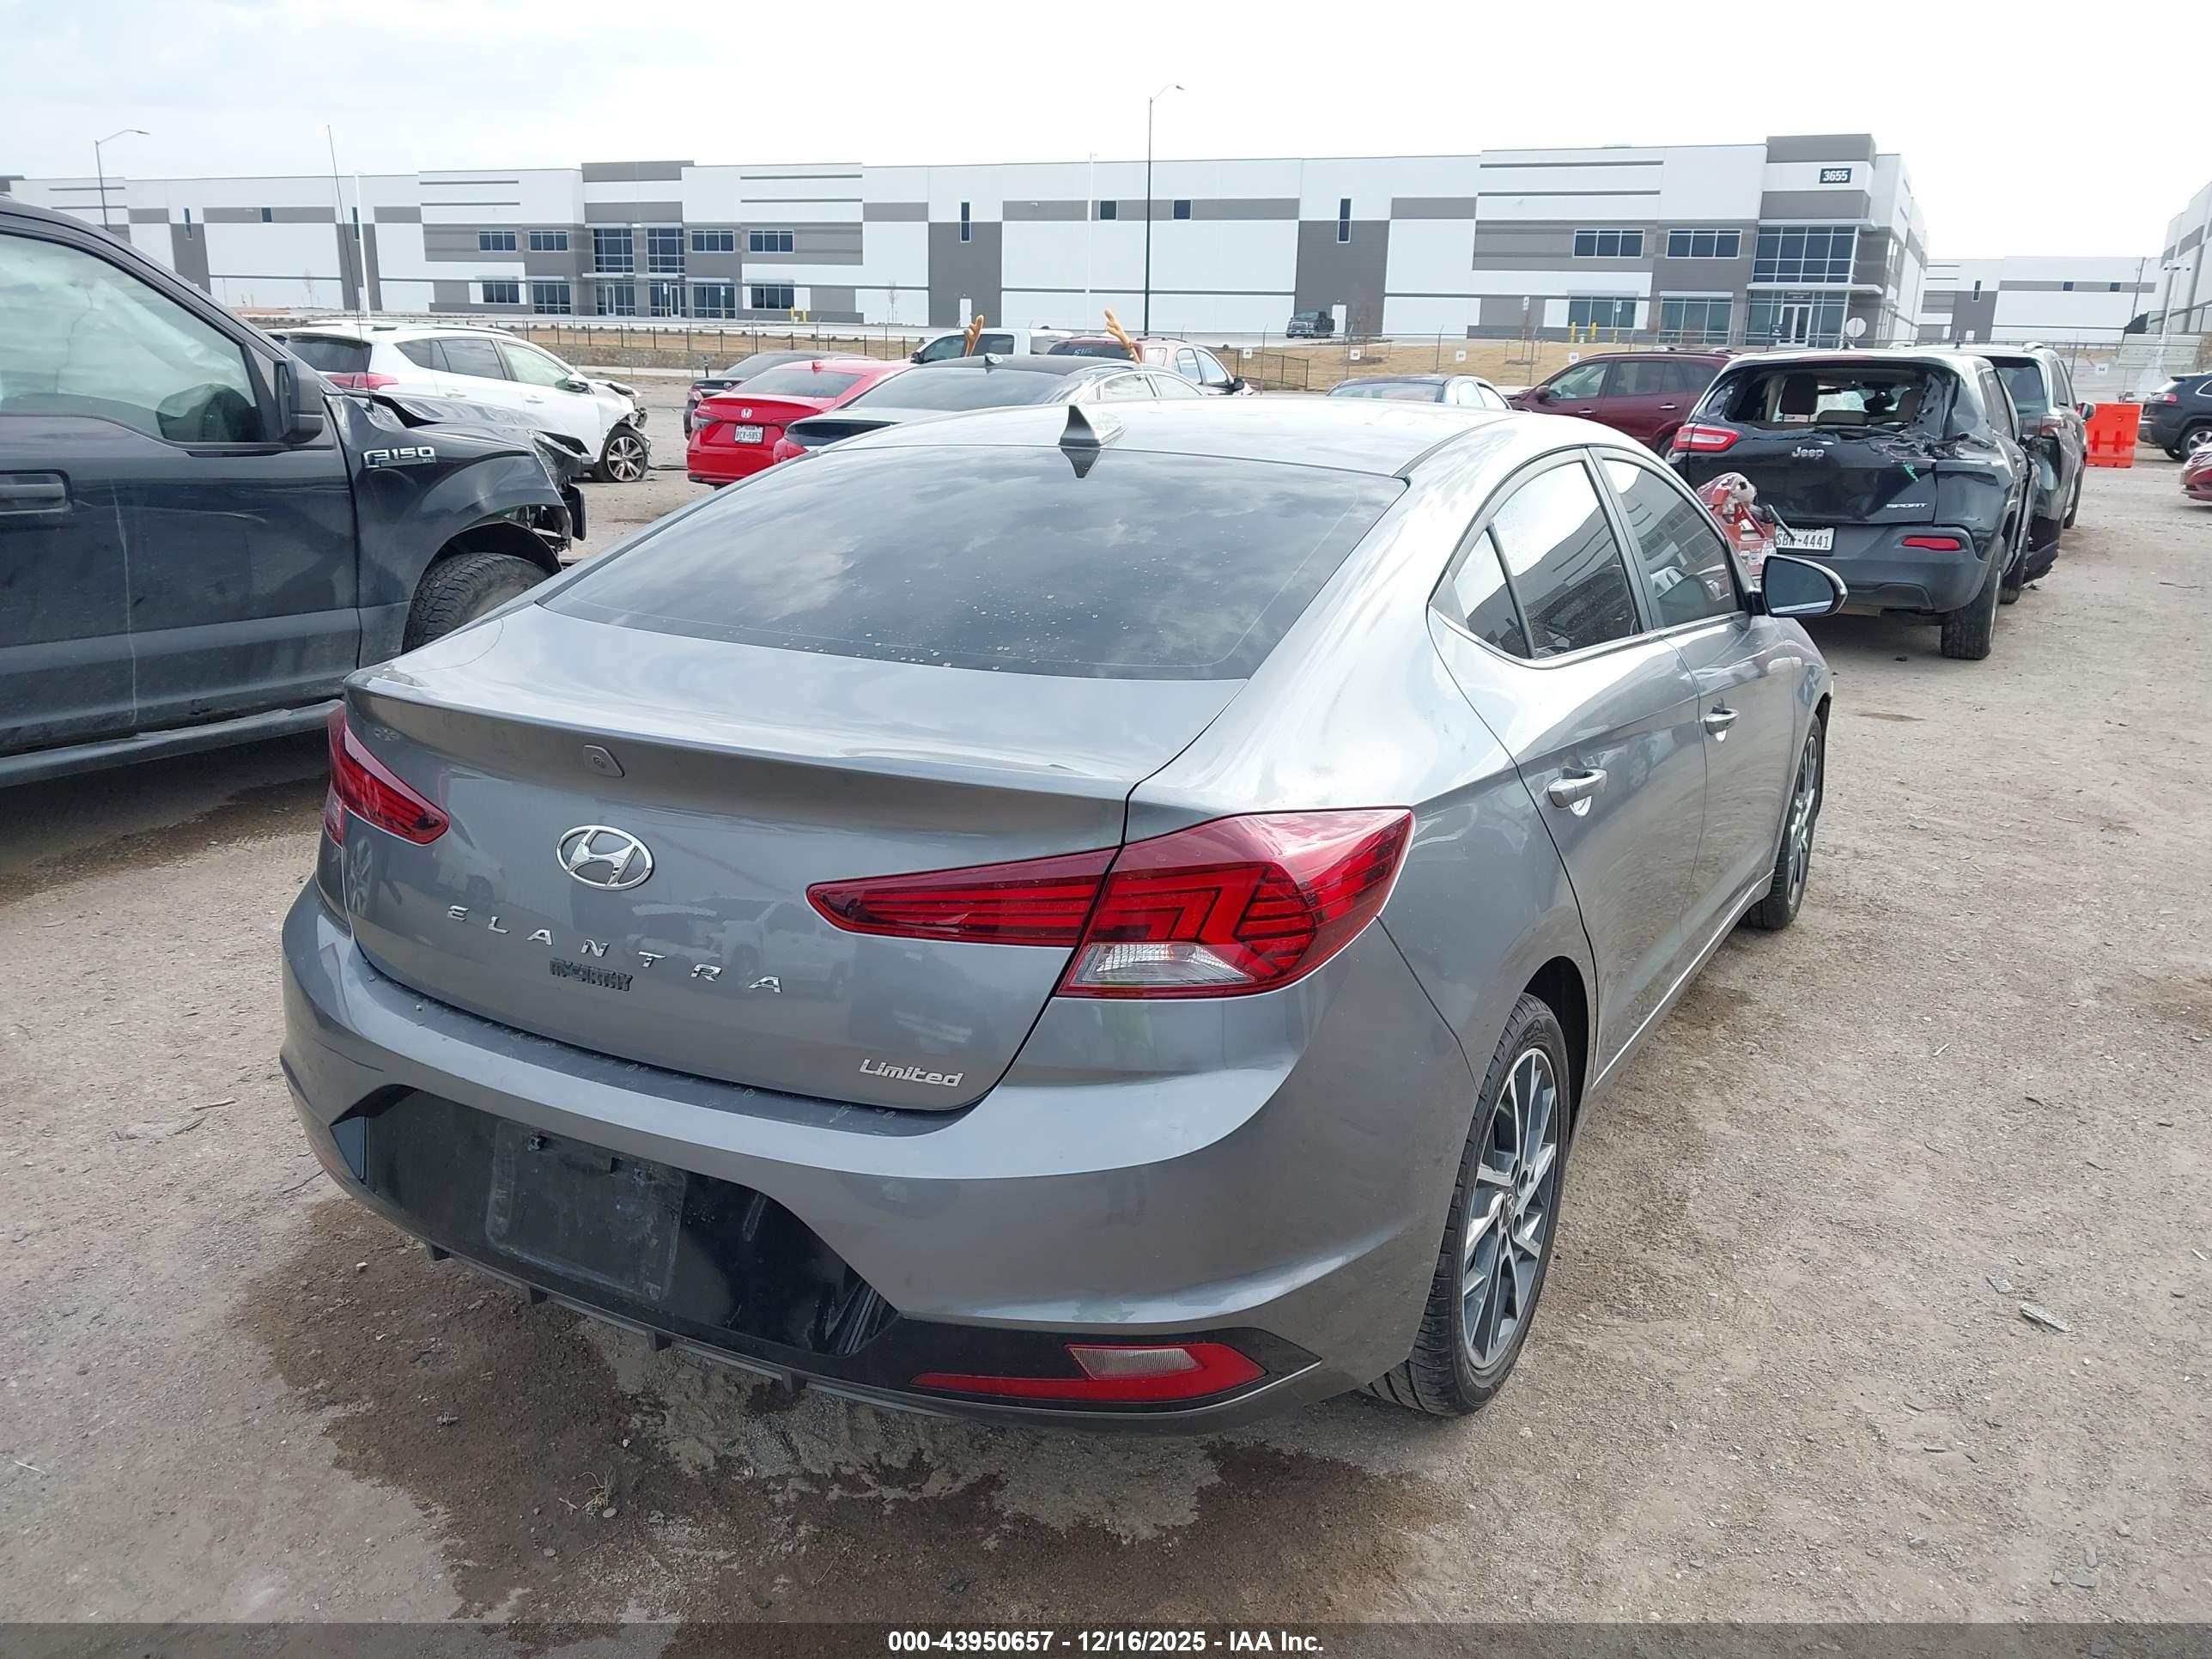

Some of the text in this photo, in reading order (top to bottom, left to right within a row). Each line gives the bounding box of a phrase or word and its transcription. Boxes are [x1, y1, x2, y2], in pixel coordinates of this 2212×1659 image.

[1822, 170, 1849, 181] 3655
[362, 446, 435, 469] F150
[1792, 446, 1825, 459] Jeep
[447, 904, 783, 994] ELANTRA
[859, 1058, 964, 1087] Limited
